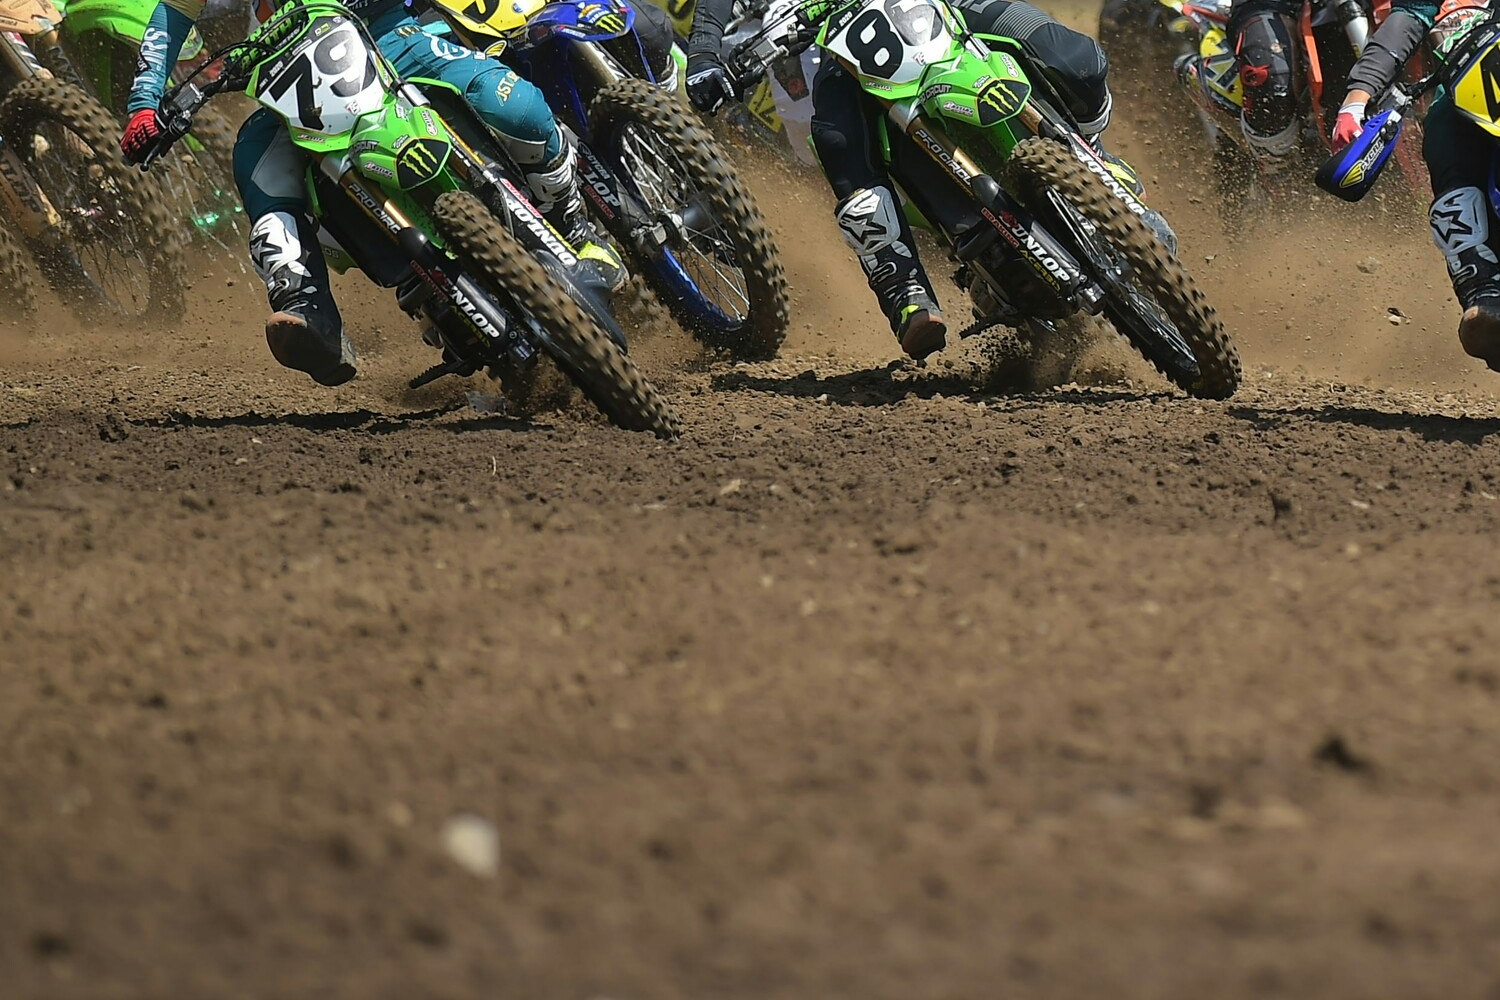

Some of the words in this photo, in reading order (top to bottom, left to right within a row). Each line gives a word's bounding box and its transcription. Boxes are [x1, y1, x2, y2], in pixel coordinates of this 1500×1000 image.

[838, 11, 853, 28] 2020
[268, 29, 377, 131] 79
[915, 129, 942, 156] PRO
[1361, 138, 1385, 171] CYCRA
[349, 182, 376, 210] PRO
[1075, 149, 1146, 215] DUNLOP
[504, 196, 578, 267] DUNLOP
[983, 209, 1018, 247] BRAKING
[1019, 249, 1061, 293] ACERBIS
